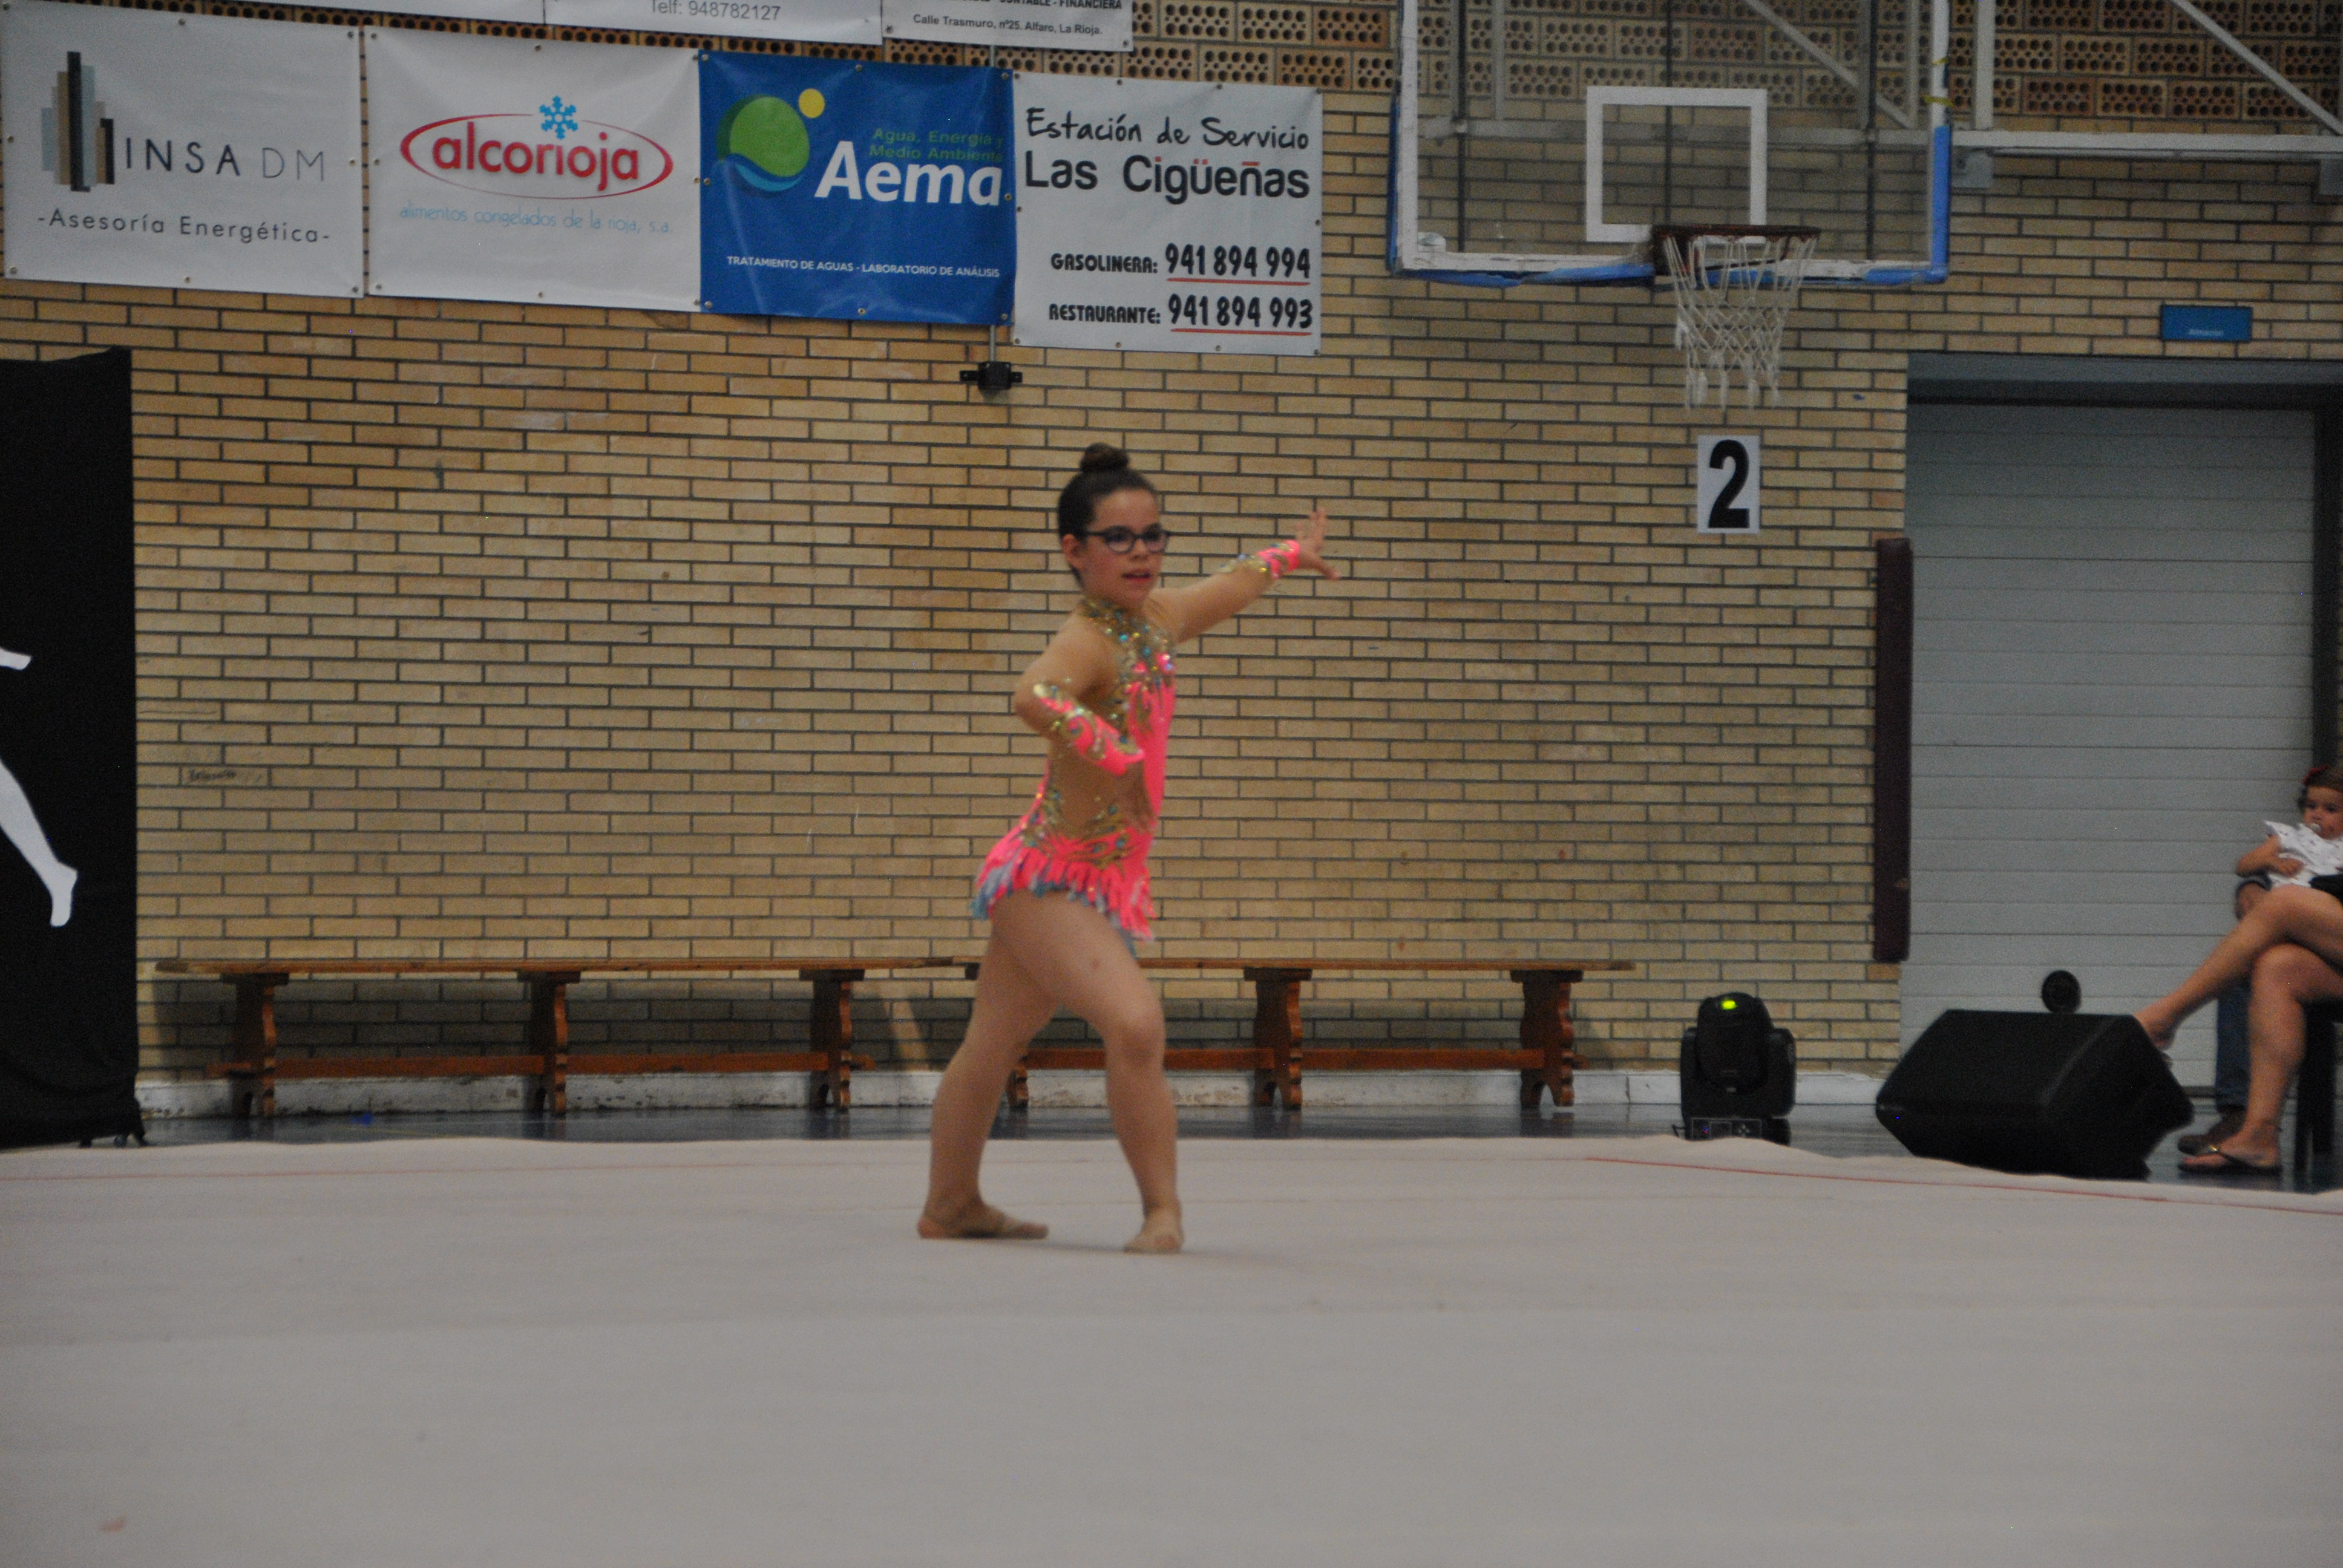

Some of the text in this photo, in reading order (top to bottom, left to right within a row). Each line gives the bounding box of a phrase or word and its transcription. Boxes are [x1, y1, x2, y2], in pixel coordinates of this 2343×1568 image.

[689, 1, 781, 20] 948782127
[913, 14, 939, 25] Calle
[943, 16, 997, 29] Trasmuro,
[1025, 22, 1057, 33] Alfaro,
[1060, 25, 1072, 33] La
[1075, 25, 1103, 36] Rioja.
[873, 128, 920, 144] Agua,
[1027, 108, 1309, 150] Estación de Servicio
[126, 138, 324, 181] INSA DM
[432, 122, 638, 191] alcorioja
[870, 145, 1004, 162] Medio Ambiente
[814, 141, 1002, 206] Aema
[1025, 150, 1310, 205] Las Cigüeñas
[400, 198, 467, 222] alimentos
[474, 206, 556, 227] congelados
[563, 209, 583, 228] de
[591, 209, 601, 229] la
[608, 215, 640, 234] rioja,
[727, 256, 798, 269] TRATAMIENTO
[801, 261, 814, 270] DE
[817, 261, 854, 272] AGUAS
[862, 264, 937, 275] LABORATORIO
[940, 267, 953, 275] DE
[955, 266, 1000, 278] ANÁLISIS
[1050, 243, 1311, 278] GASOLINERA: 941 894 994
[1049, 294, 1313, 329] RESTAURANTE: 941 894 993
[1708, 439, 1750, 528] 2
